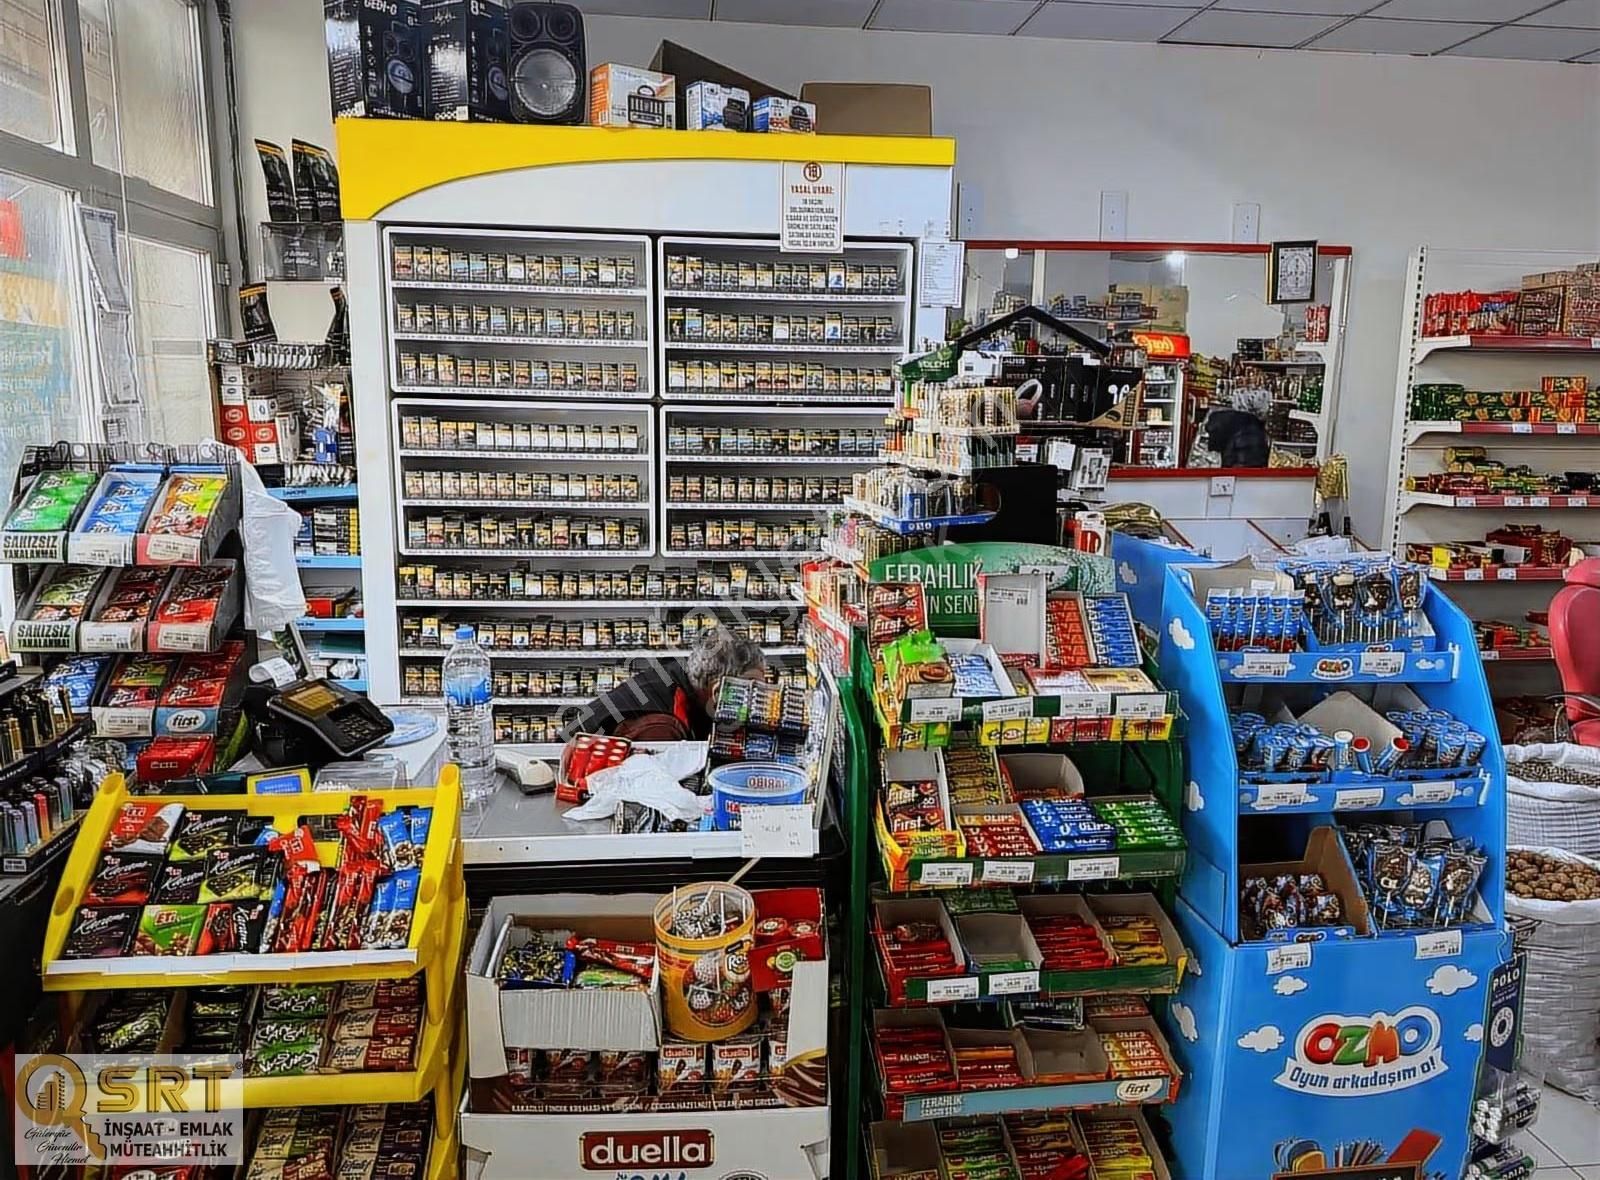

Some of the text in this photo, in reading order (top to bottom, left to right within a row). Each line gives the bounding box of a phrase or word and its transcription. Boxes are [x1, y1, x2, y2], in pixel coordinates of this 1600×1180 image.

[1492, 968, 1520, 991] POLO
[1304, 1015, 1433, 1068] OZMO
[1289, 1066, 1329, 1089] Oyun
[590, 1136, 706, 1165] duella
